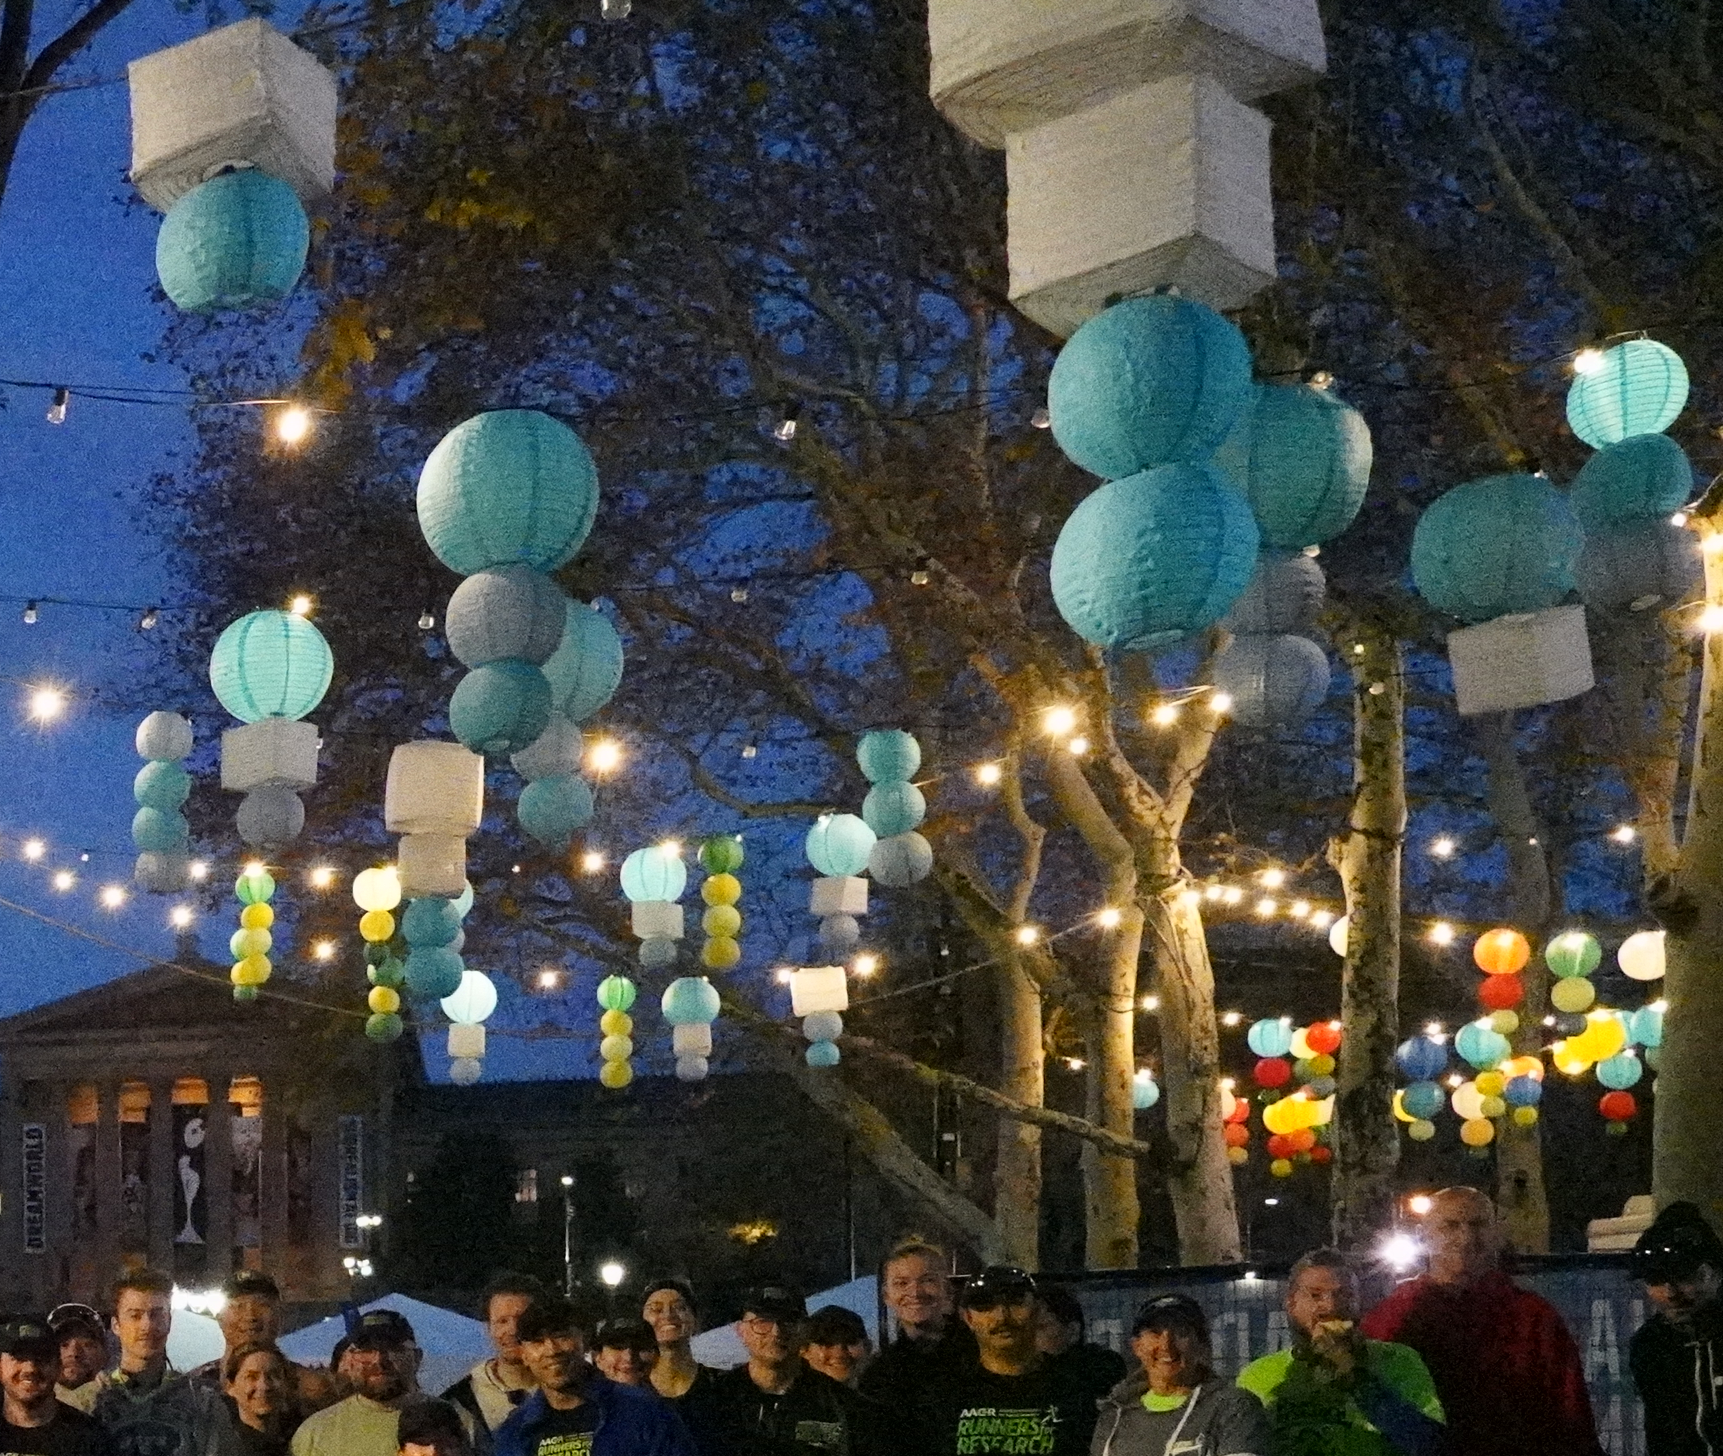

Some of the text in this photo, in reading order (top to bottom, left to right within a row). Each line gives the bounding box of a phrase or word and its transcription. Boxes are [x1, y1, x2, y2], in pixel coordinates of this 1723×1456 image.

[960, 1407, 996, 1418] AACR
[957, 1418, 1040, 1437] RUNNERS
[956, 1436, 1055, 1456] RESEARCH
